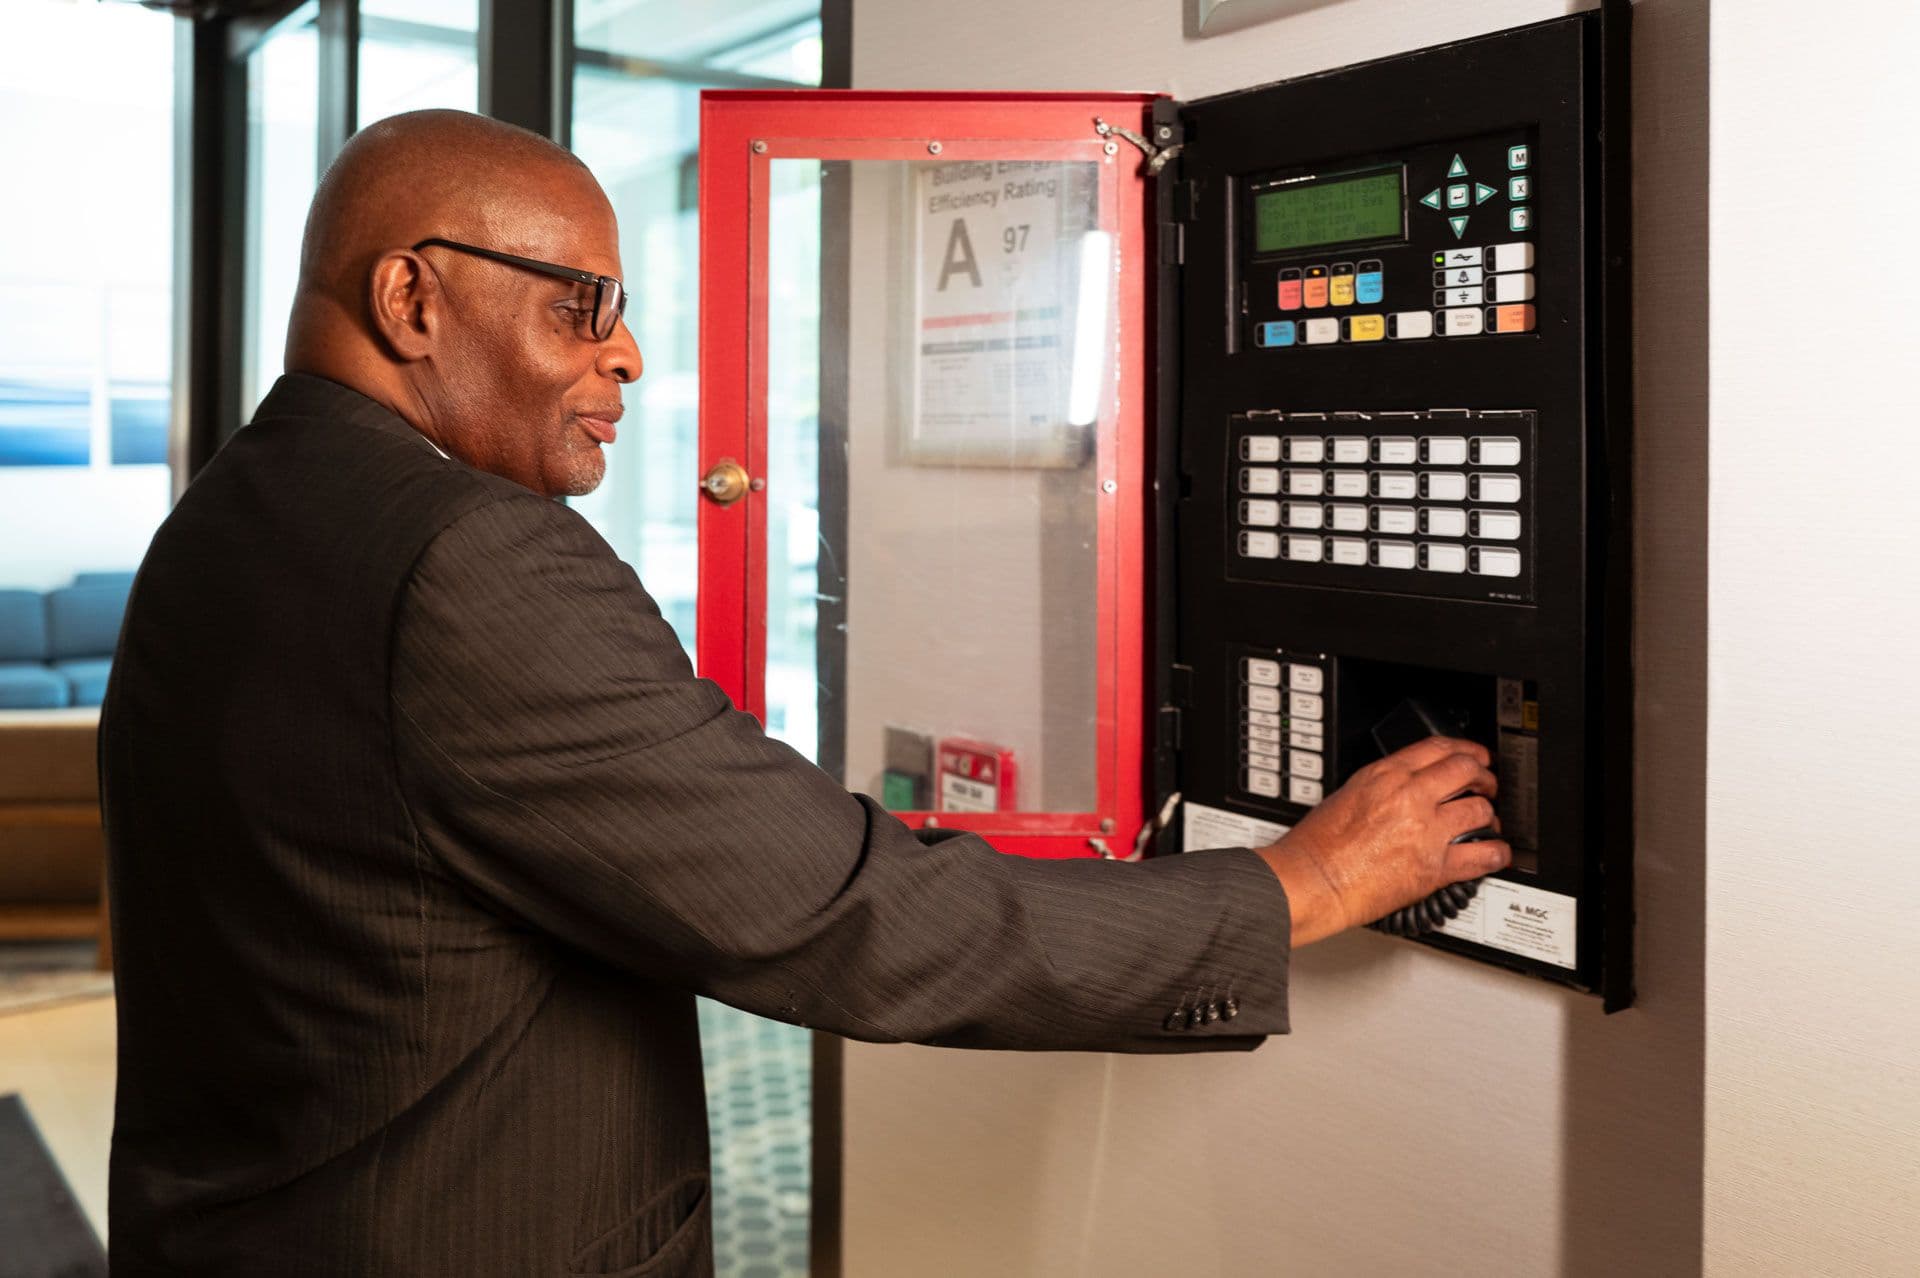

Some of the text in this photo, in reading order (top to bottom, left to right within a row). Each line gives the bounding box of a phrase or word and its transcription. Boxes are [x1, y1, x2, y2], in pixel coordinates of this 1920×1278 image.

[1515, 153, 1526, 163] M
[932, 162, 992, 187] Building
[928, 178, 1056, 214] Efficiency Rating
[1517, 184, 1525, 193] X
[1519, 214, 1526, 225] ?
[937, 218, 1031, 291] A 97
[1525, 905, 1549, 920] MGC
